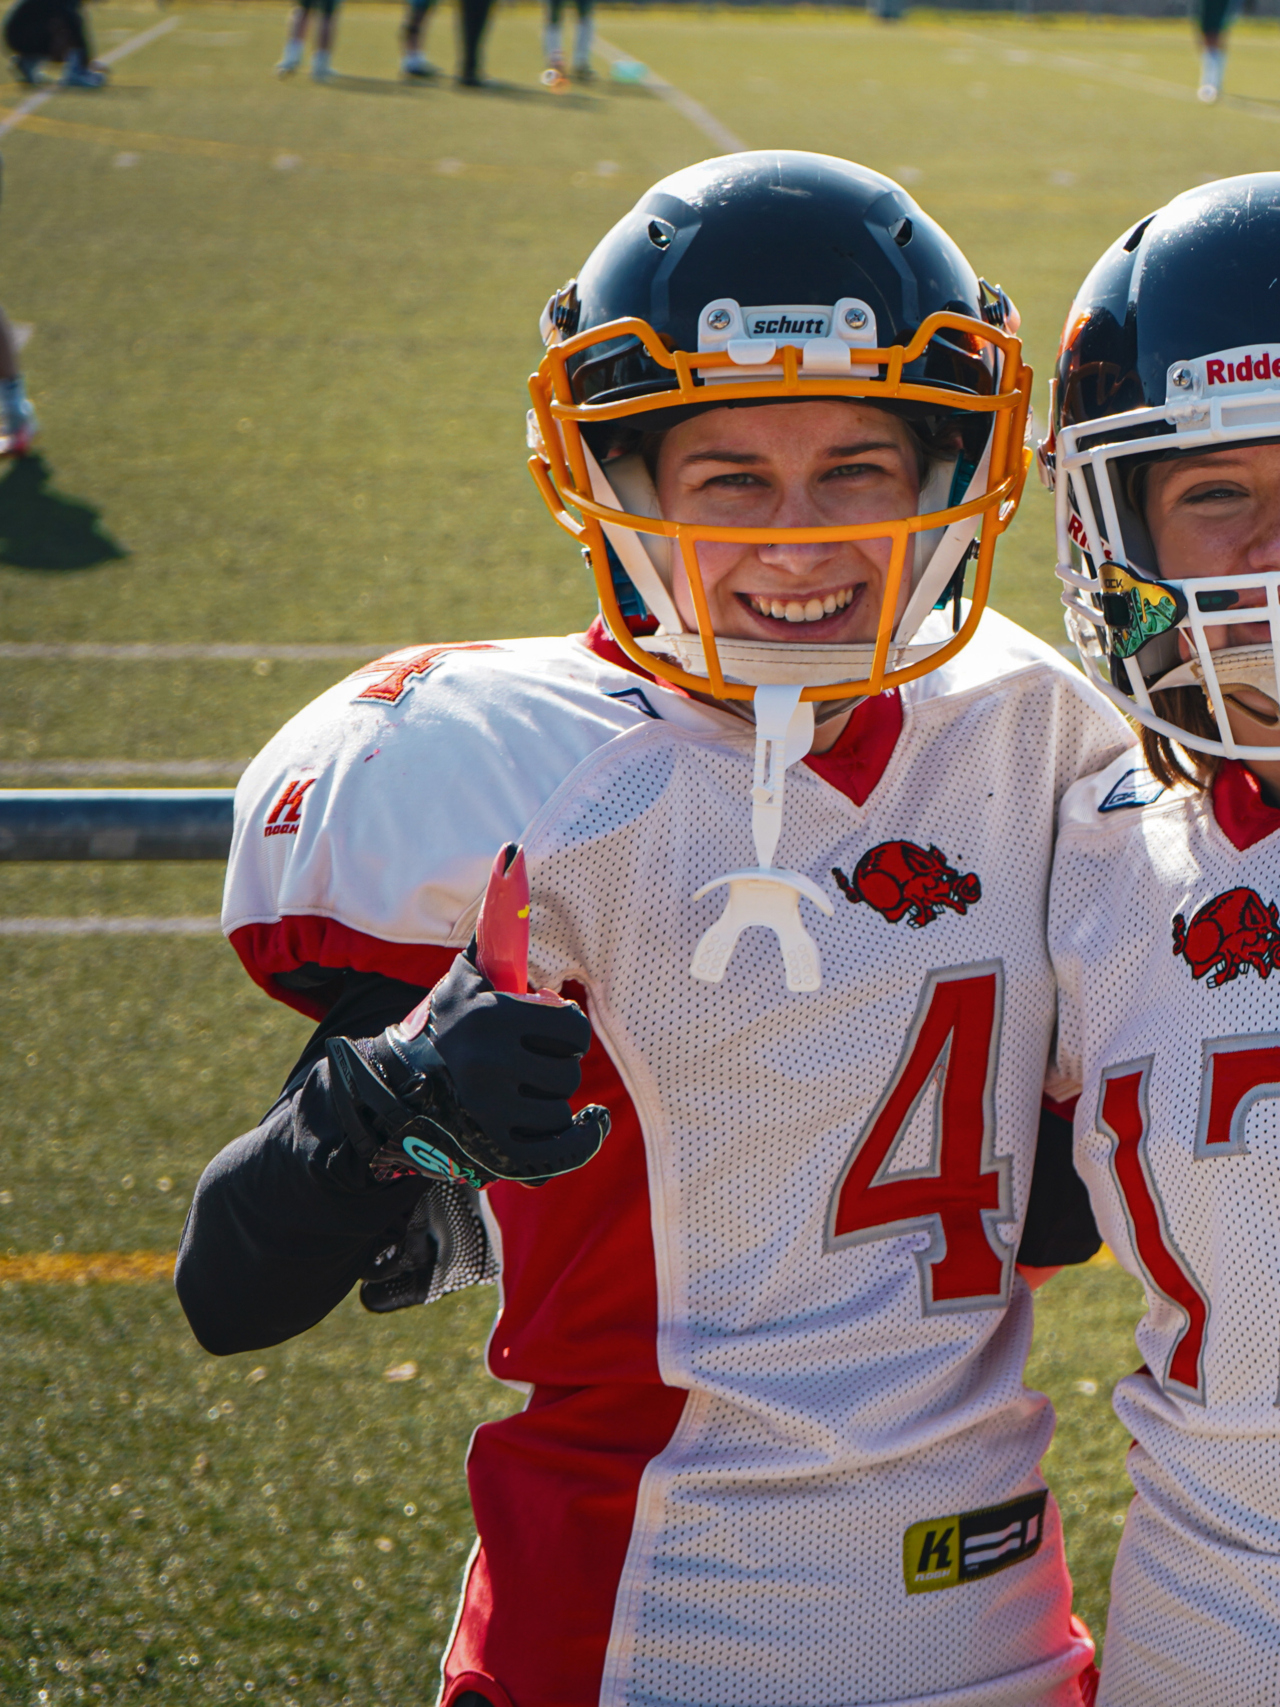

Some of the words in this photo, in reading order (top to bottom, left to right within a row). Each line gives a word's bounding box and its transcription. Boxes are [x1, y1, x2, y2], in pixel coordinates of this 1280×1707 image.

[753, 315, 824, 334] schutt
[823, 958, 1016, 1318] 4
[917, 1526, 955, 1573] K
